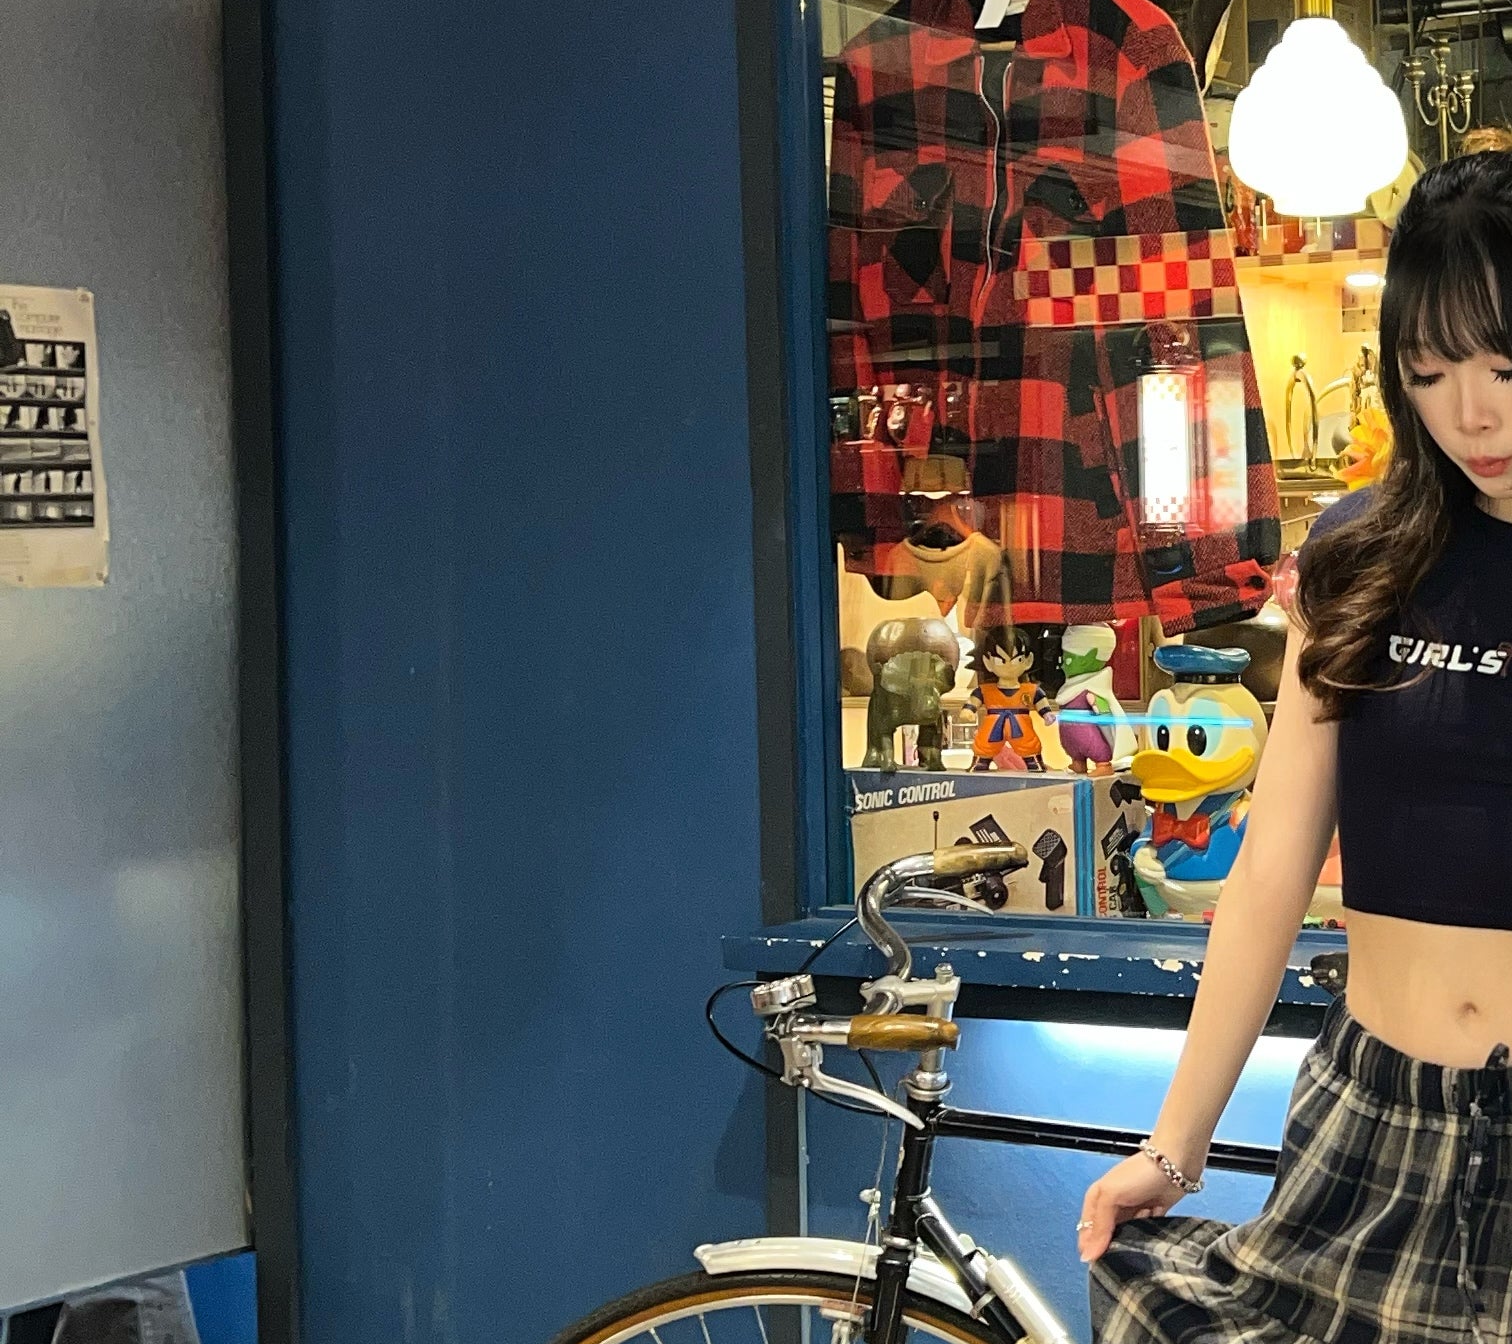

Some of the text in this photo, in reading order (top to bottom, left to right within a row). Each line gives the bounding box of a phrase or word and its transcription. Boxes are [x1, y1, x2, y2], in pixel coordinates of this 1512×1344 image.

[855, 780, 956, 810] SONIC CONTROL
[1097, 866, 1107, 916] ONTROL
